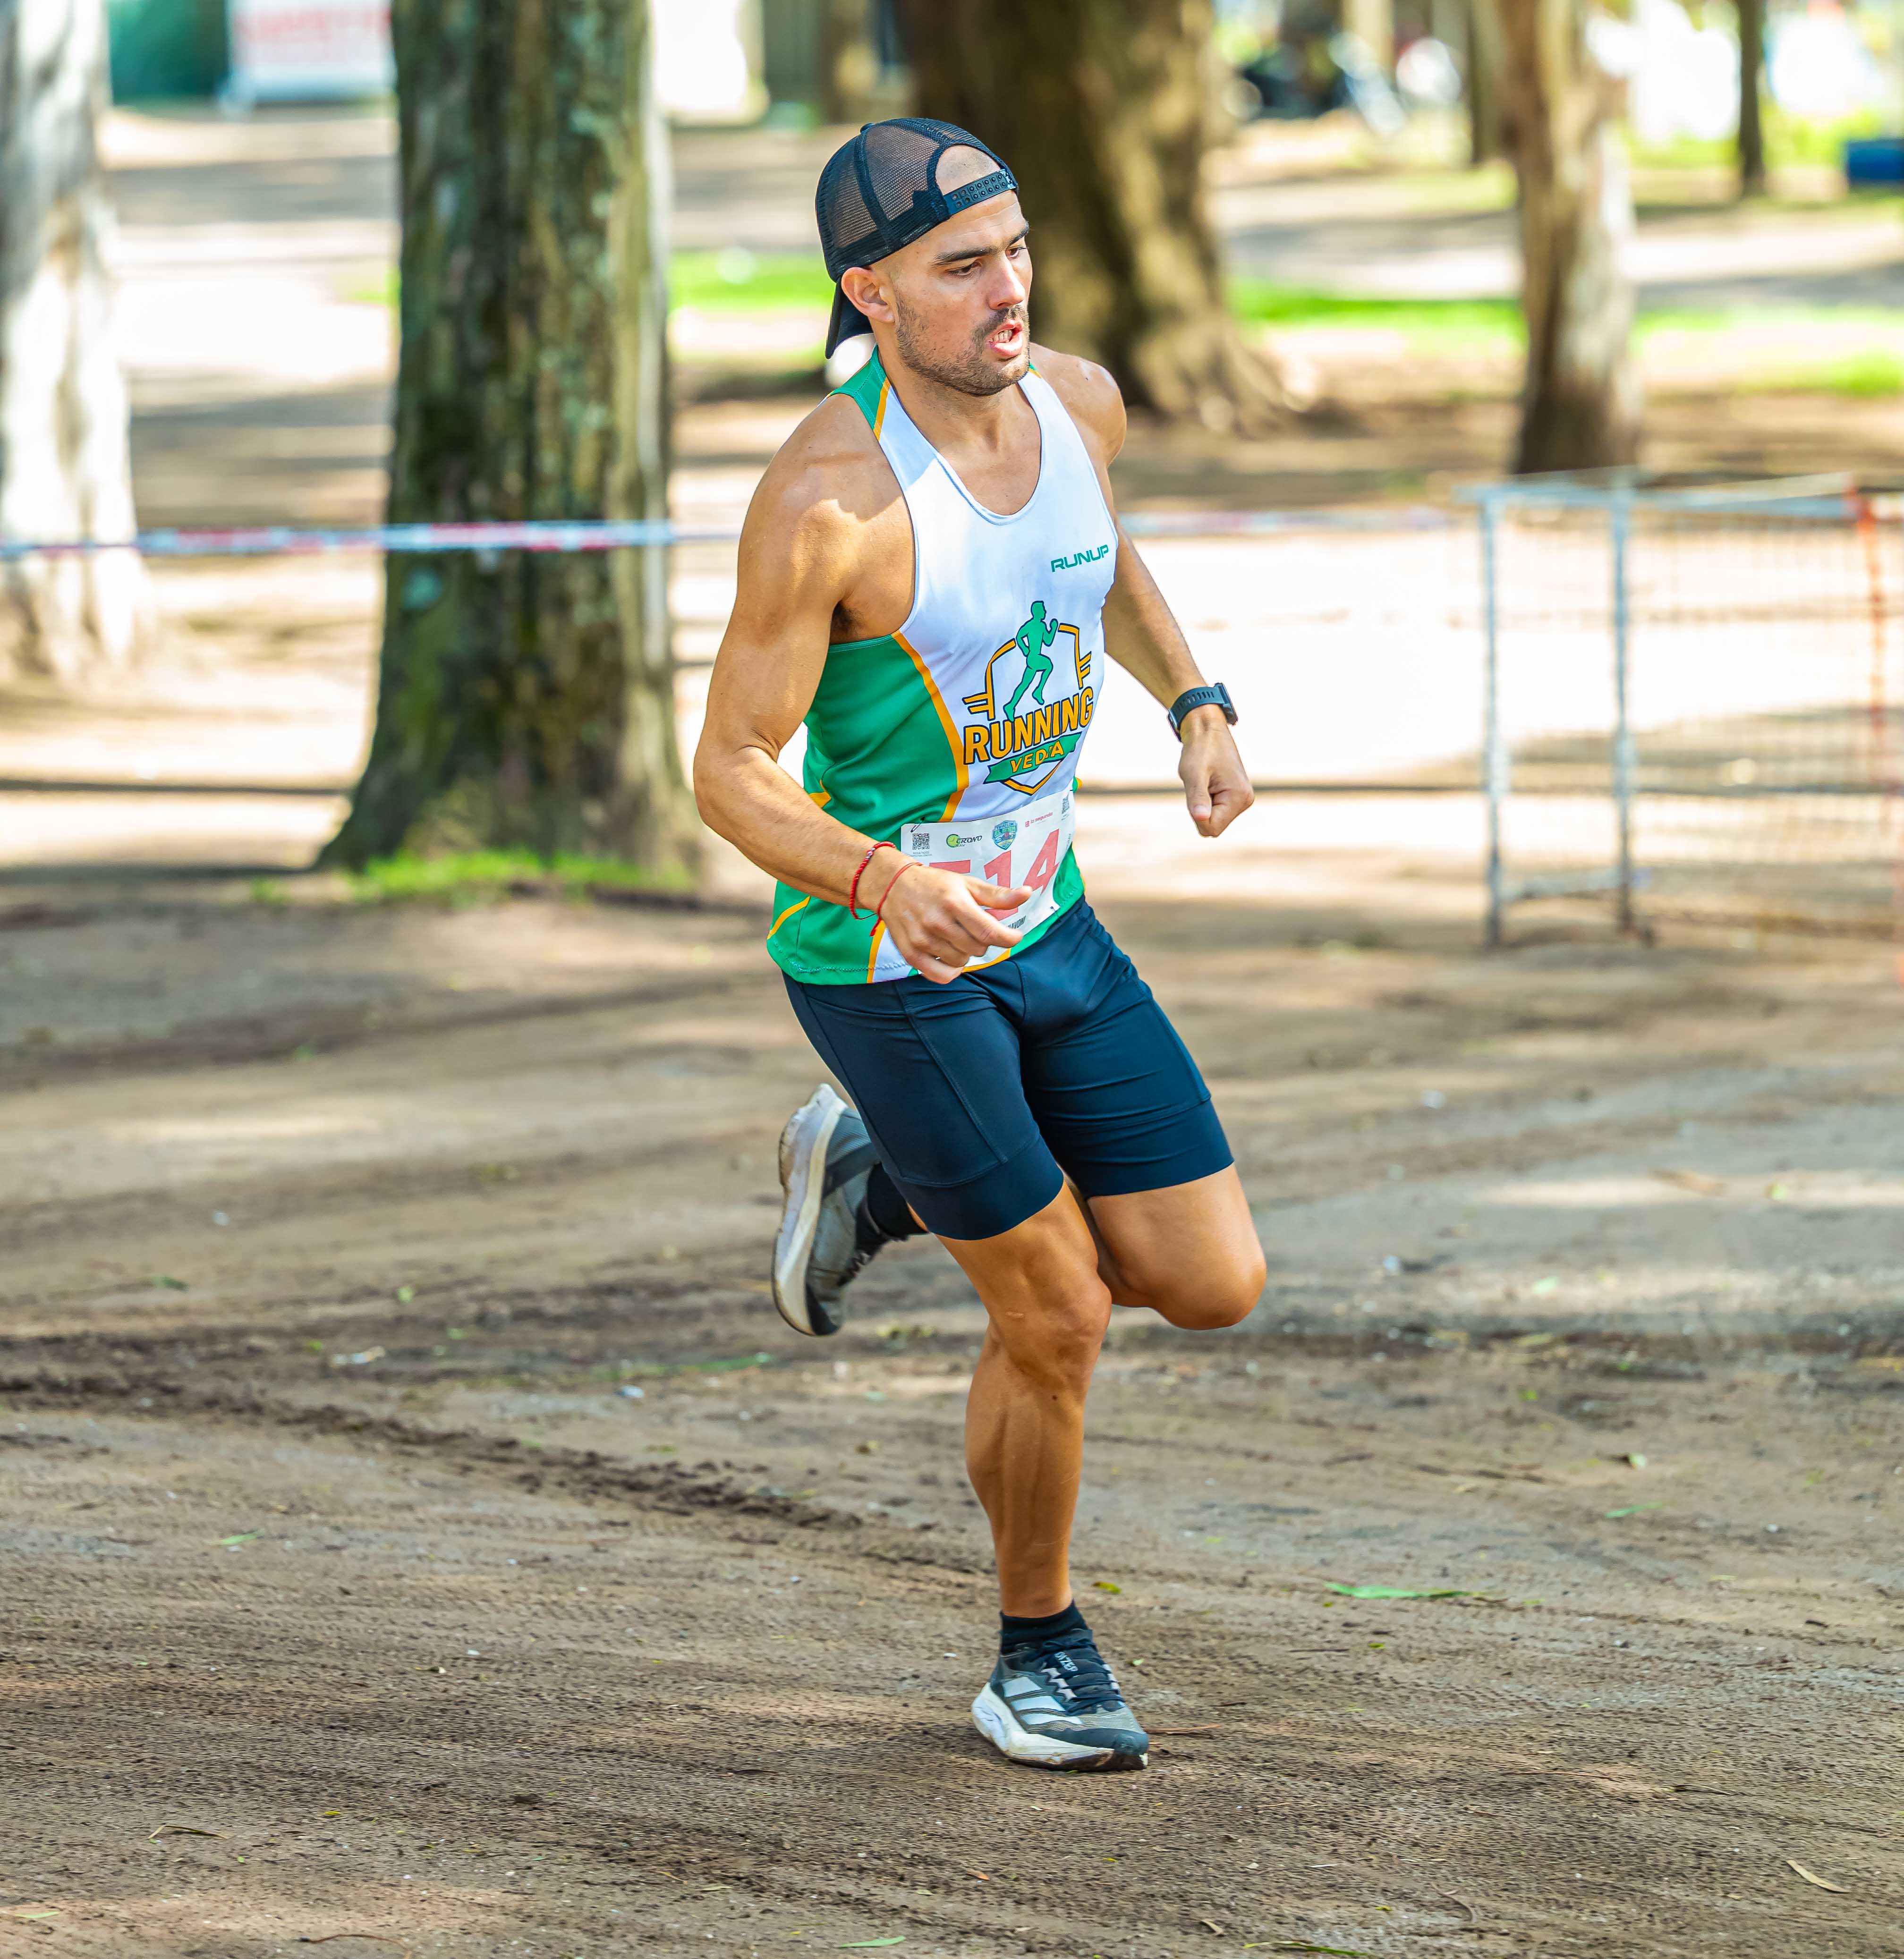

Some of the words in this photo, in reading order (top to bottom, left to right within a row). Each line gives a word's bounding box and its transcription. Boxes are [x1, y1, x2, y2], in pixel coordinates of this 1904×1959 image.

[1051, 544, 1109, 572] RUNUP
[964, 686, 1094, 765] RUNNING
[929, 829, 1060, 921] 14
